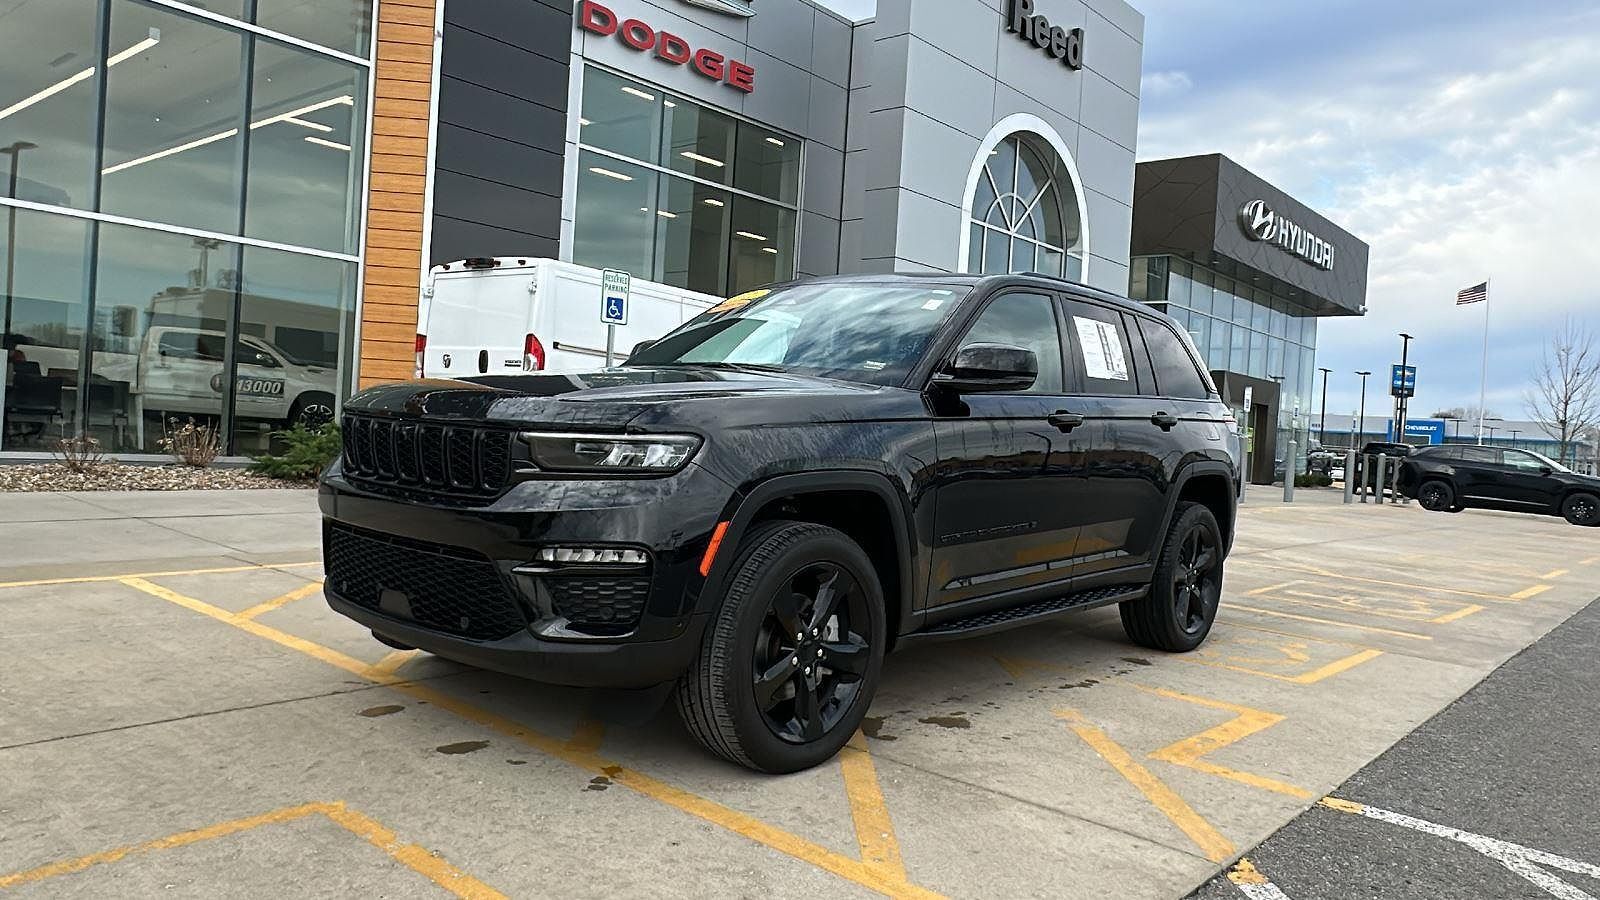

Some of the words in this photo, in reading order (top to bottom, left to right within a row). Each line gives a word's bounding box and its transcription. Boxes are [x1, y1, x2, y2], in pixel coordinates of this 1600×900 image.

[579, 0, 755, 93] DODGE
[1008, 0, 1083, 70] Reed
[1278, 216, 1335, 270] HYUNDAI
[604, 283, 628, 294] PARKING
